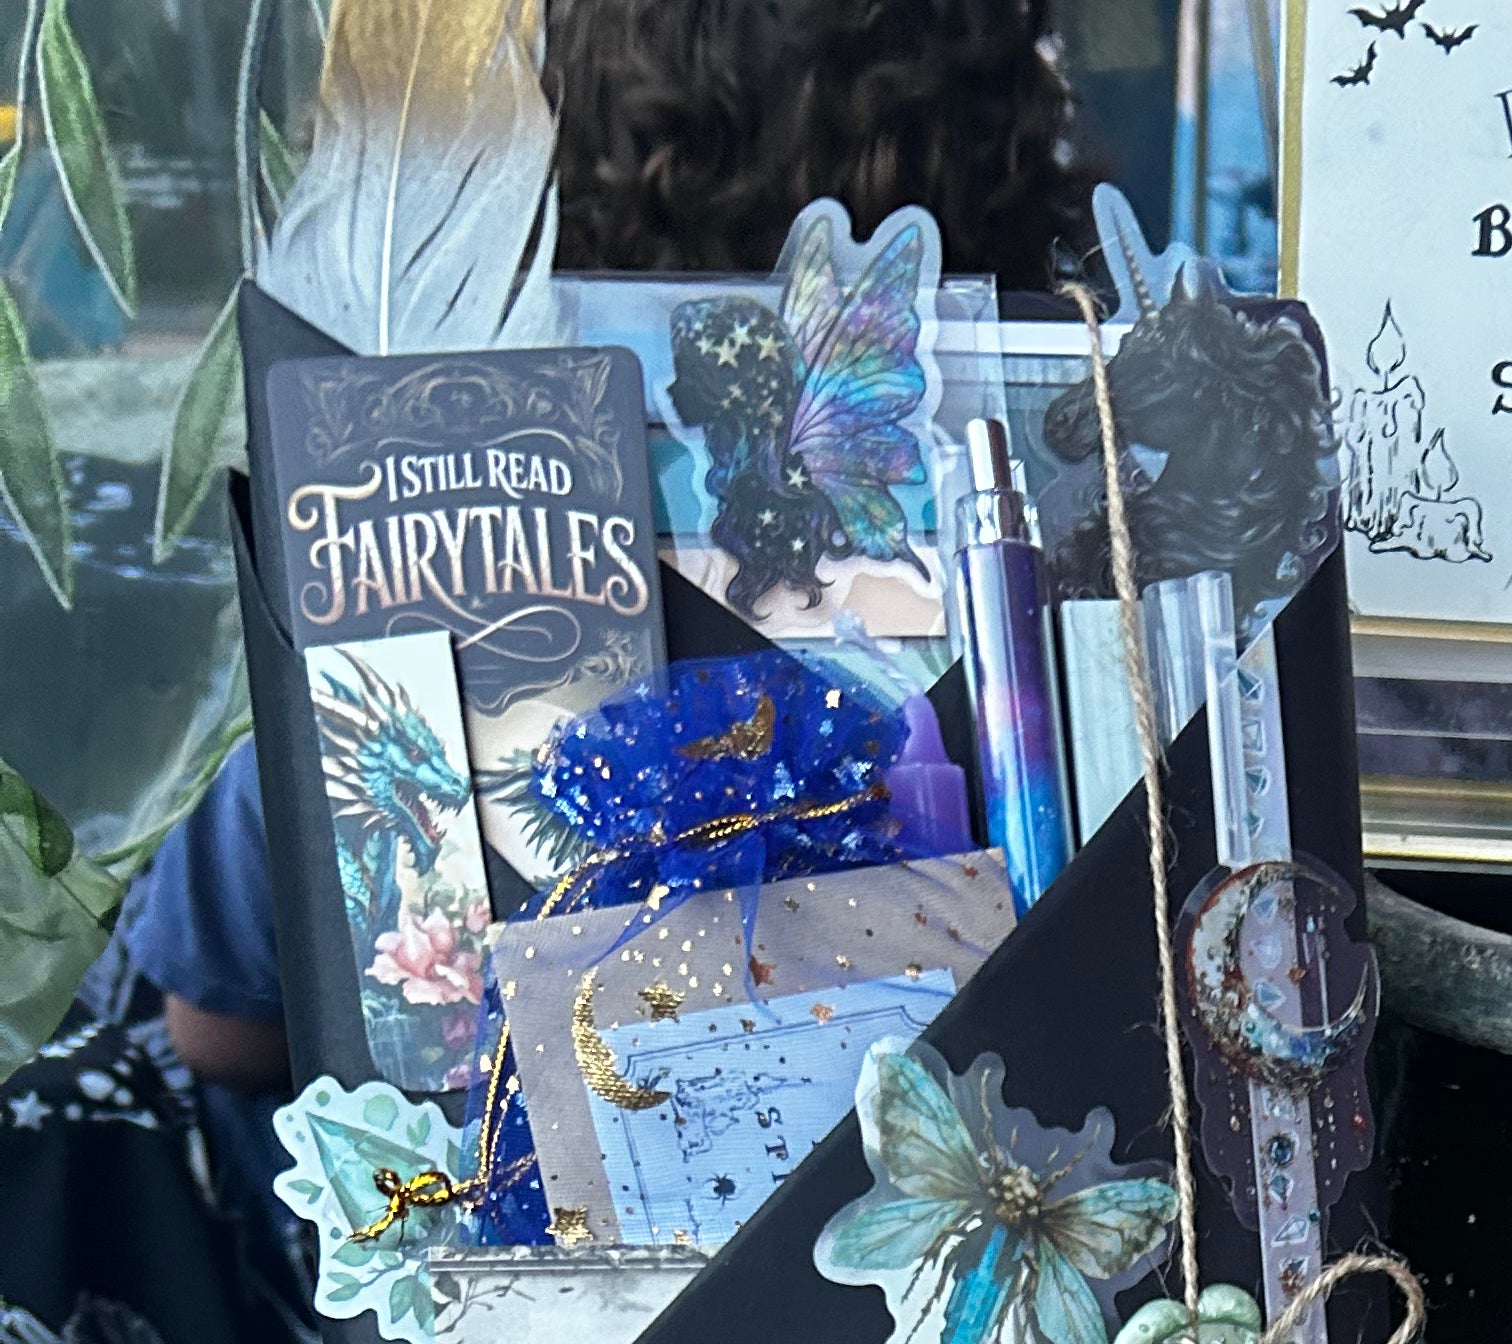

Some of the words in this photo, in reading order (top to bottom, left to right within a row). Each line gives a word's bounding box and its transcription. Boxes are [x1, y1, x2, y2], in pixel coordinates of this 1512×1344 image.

[386, 454, 397, 501] I
[402, 454, 481, 497] STILL
[489, 449, 573, 499] READ
[288, 461, 649, 626] FAIRYTALES
